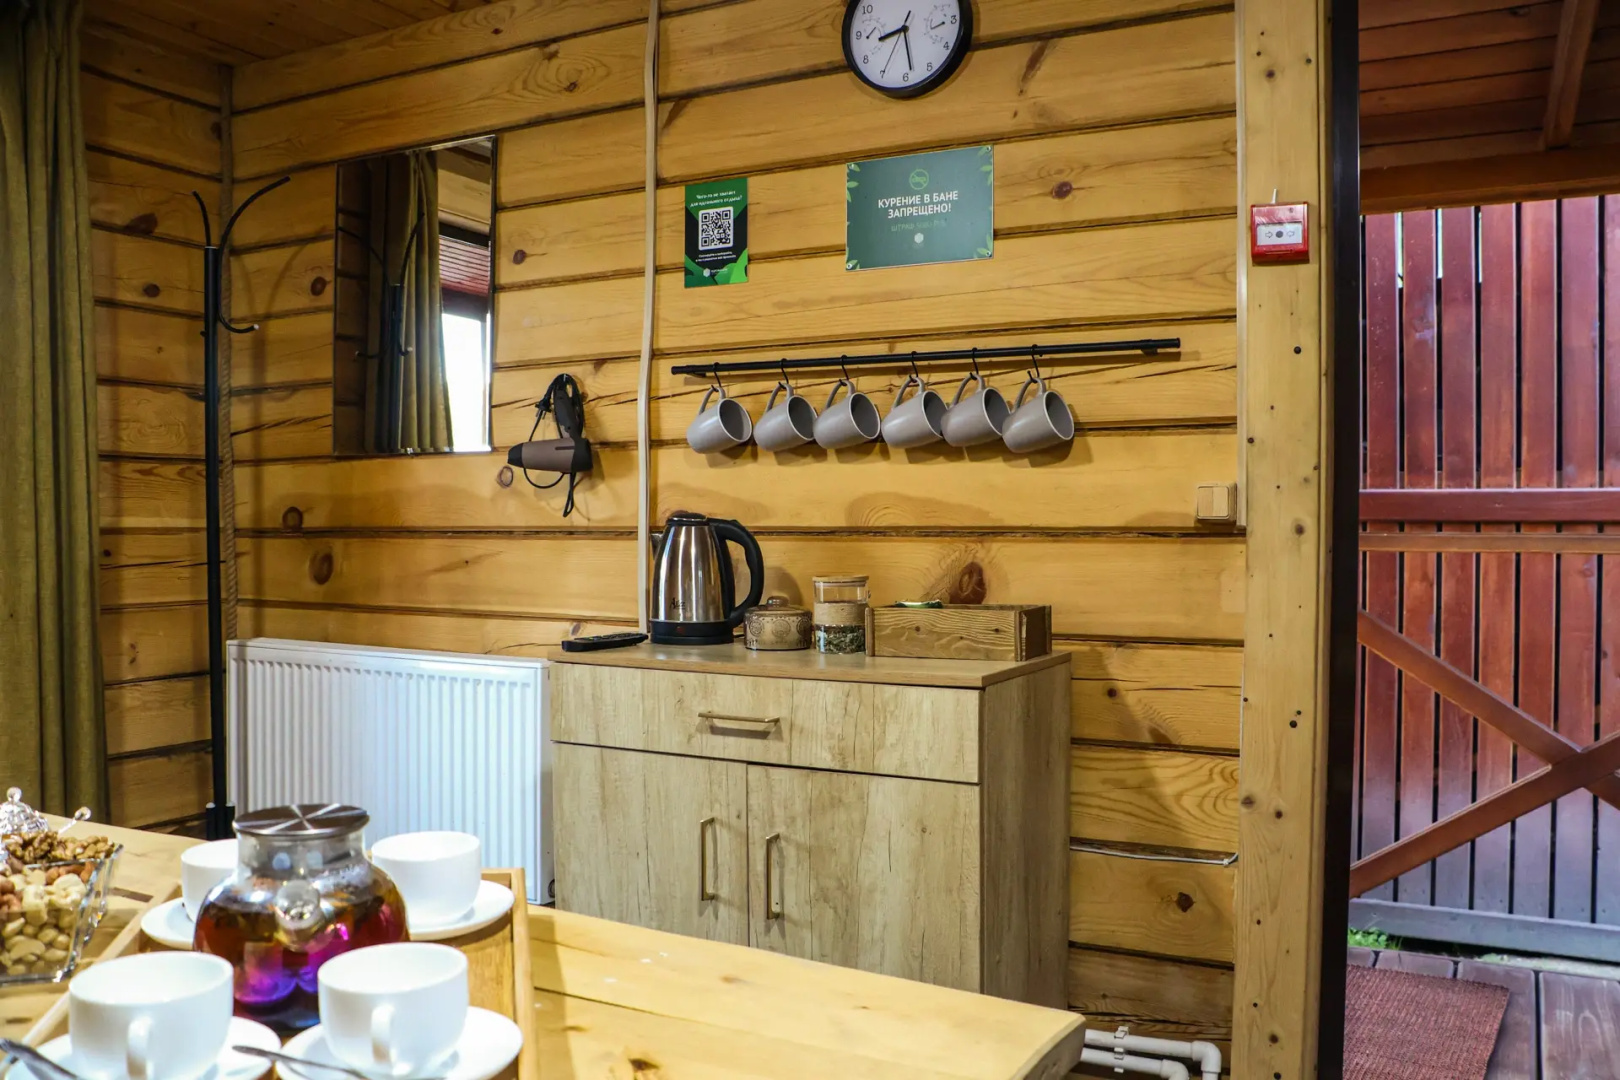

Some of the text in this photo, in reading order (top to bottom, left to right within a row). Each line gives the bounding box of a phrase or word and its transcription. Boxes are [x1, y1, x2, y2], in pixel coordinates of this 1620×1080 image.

[862, 5, 873, 15] 10
[950, 15, 957, 24] 3
[855, 31, 862, 40] 9
[943, 41, 950, 50] 4
[862, 55, 869, 64] 8
[926, 62, 933, 71] 5
[879, 70, 886, 78] 7
[902, 73, 909, 82] 6
[878, 191, 959, 208] КУРЕНИЕ В БАНЕ
[888, 203, 951, 219] ЗАПРЕЩЕНО!
